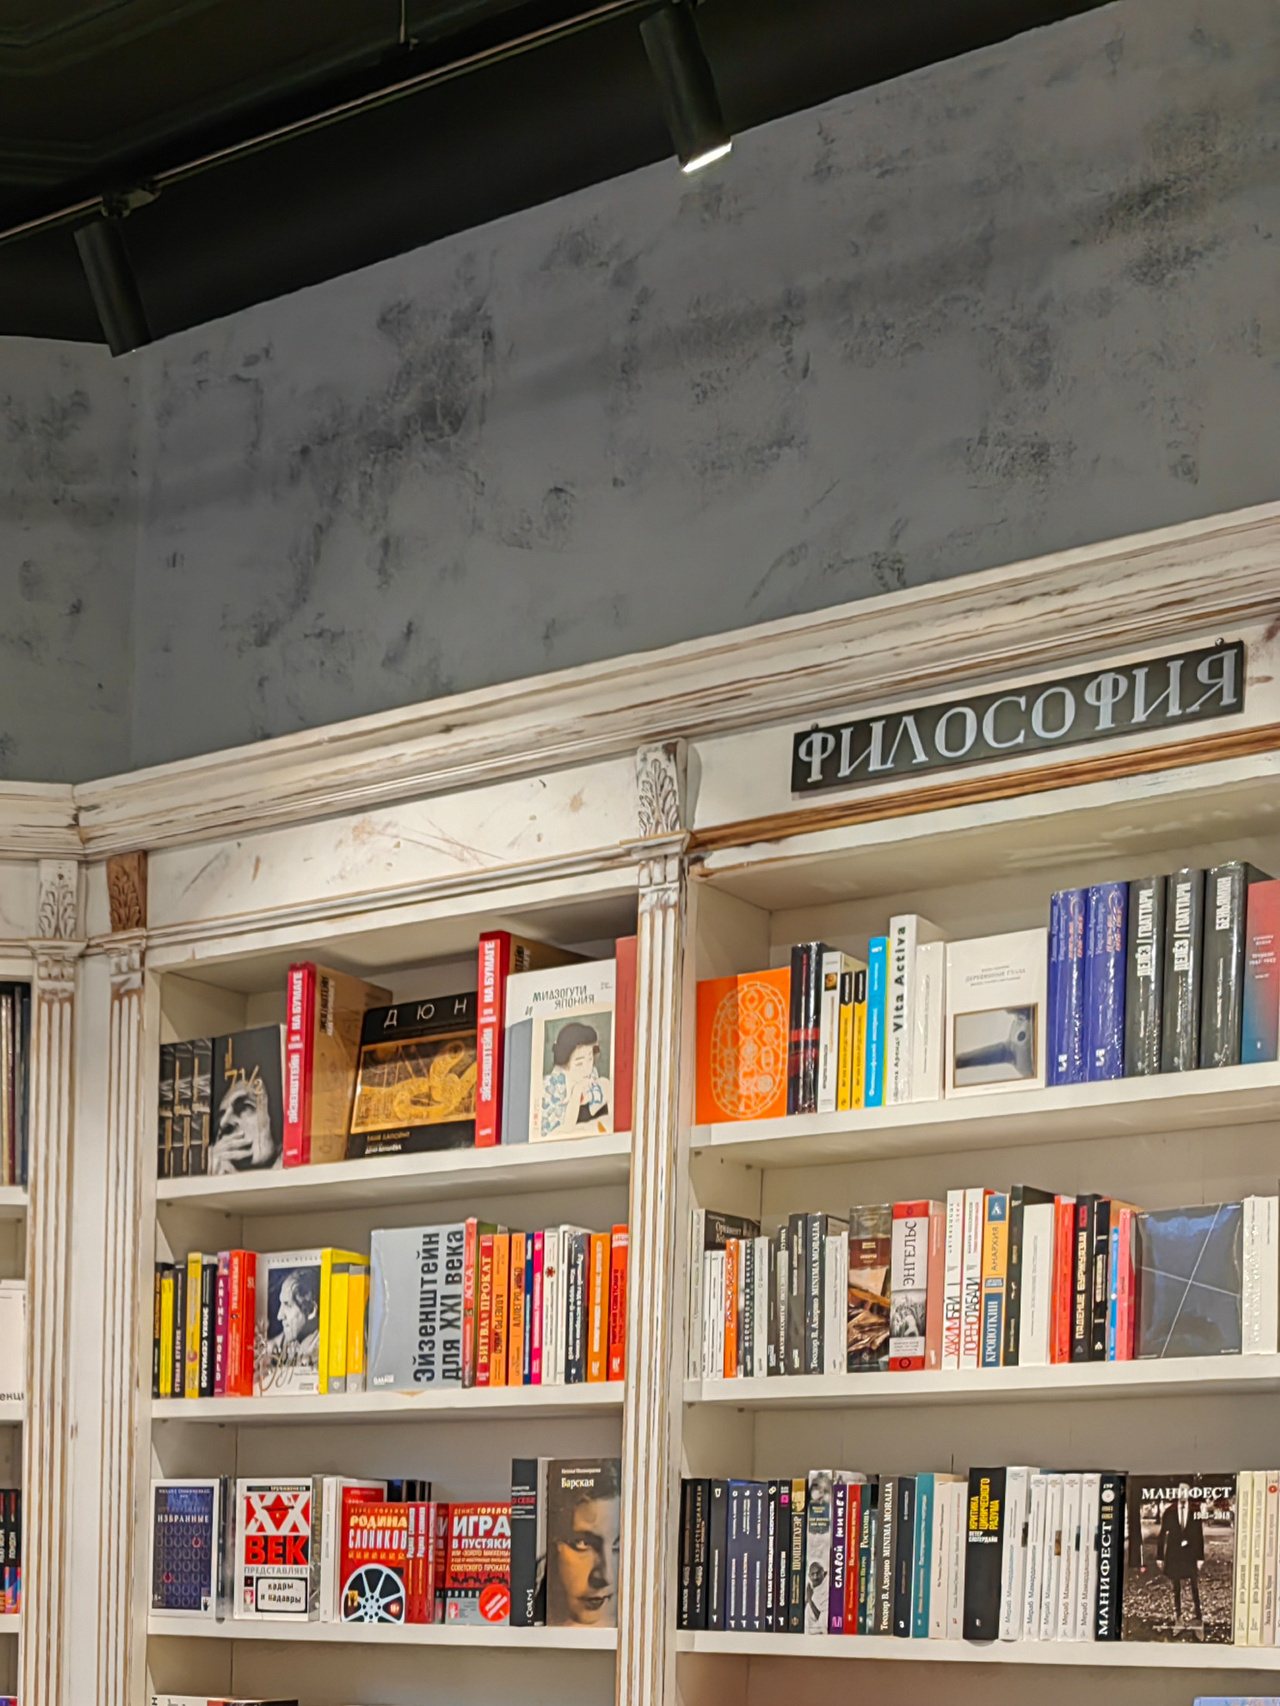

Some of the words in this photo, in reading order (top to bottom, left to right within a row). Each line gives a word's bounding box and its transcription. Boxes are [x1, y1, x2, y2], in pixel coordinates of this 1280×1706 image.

[797, 648, 1239, 783] ФИЛОСОФИЯ
[1138, 888, 1154, 938] ГВАТТАРИ
[1175, 881, 1192, 932] ГВАТТАРИ
[484, 941, 495, 988] БУМАГЕ
[894, 926, 905, 986] Activa
[1134, 945, 1153, 977] ДЕЛЁЗ
[1172, 939, 1191, 972] ДЕЛЁЗ
[291, 971, 303, 1013] БУМАГЕ
[532, 985, 588, 1003] МИДЗОГУТИ
[554, 994, 595, 1010] ЯПОНИЯ
[384, 998, 467, 1028] ДЮН
[892, 994, 904, 1033] Vita
[481, 1027, 494, 1102] ЭЙЗЕНШТЕЙН
[444, 1229, 464, 1286] века
[811, 1221, 820, 1261] MORALIA
[902, 1220, 917, 1287] ЭНГЕЛЬС
[990, 1226, 999, 1272] АНАРХИЯ
[464, 1268, 474, 1301] АССА
[480, 1256, 492, 1311] ПРОКАТ
[811, 1261, 820, 1296] MINIMA
[439, 1293, 462, 1331] XXI
[811, 1298, 820, 1329] Адорно
[1076, 1294, 1086, 1340] ПАДЕНИЕ
[478, 1319, 489, 1364] БИТВА
[985, 1300, 999, 1363] КРОПОТКИН
[441, 1339, 462, 1381] для
[810, 1338, 821, 1370] Теодор
[561, 1477, 595, 1489] Барская
[1141, 1486, 1232, 1500] МАНИФЕСТ
[157, 1514, 210, 1524] ИЗБРАННЫЕ
[883, 1482, 893, 1523] MORALIA
[969, 1496, 979, 1530] КРИТИКА
[978, 1478, 990, 1530] ЦИНИЧЕСКОГО
[989, 1499, 1000, 1530] РАЗУМА
[349, 1515, 408, 1529] РОДИНА
[452, 1516, 512, 1537] ИГРА
[244, 1535, 310, 1566] ВЕК
[347, 1529, 407, 1550] СЛОНИКОВ
[461, 1539, 512, 1550] ПУСТЯКИ
[882, 1523, 891, 1558] MINIMA
[243, 1566, 309, 1575] ПРЕДСТАВЛЯЕТ
[833, 1544, 844, 1588] СЛАВОЙ
[881, 1559, 891, 1591] Адорно
[1098, 1520, 1112, 1636] МАНИФЕСТ
[268, 1582, 294, 1591] кадры
[268, 1594, 302, 1604] кадавры
[880, 1601, 891, 1631] Теодор
[1081, 1602, 1089, 1626] Мераб
